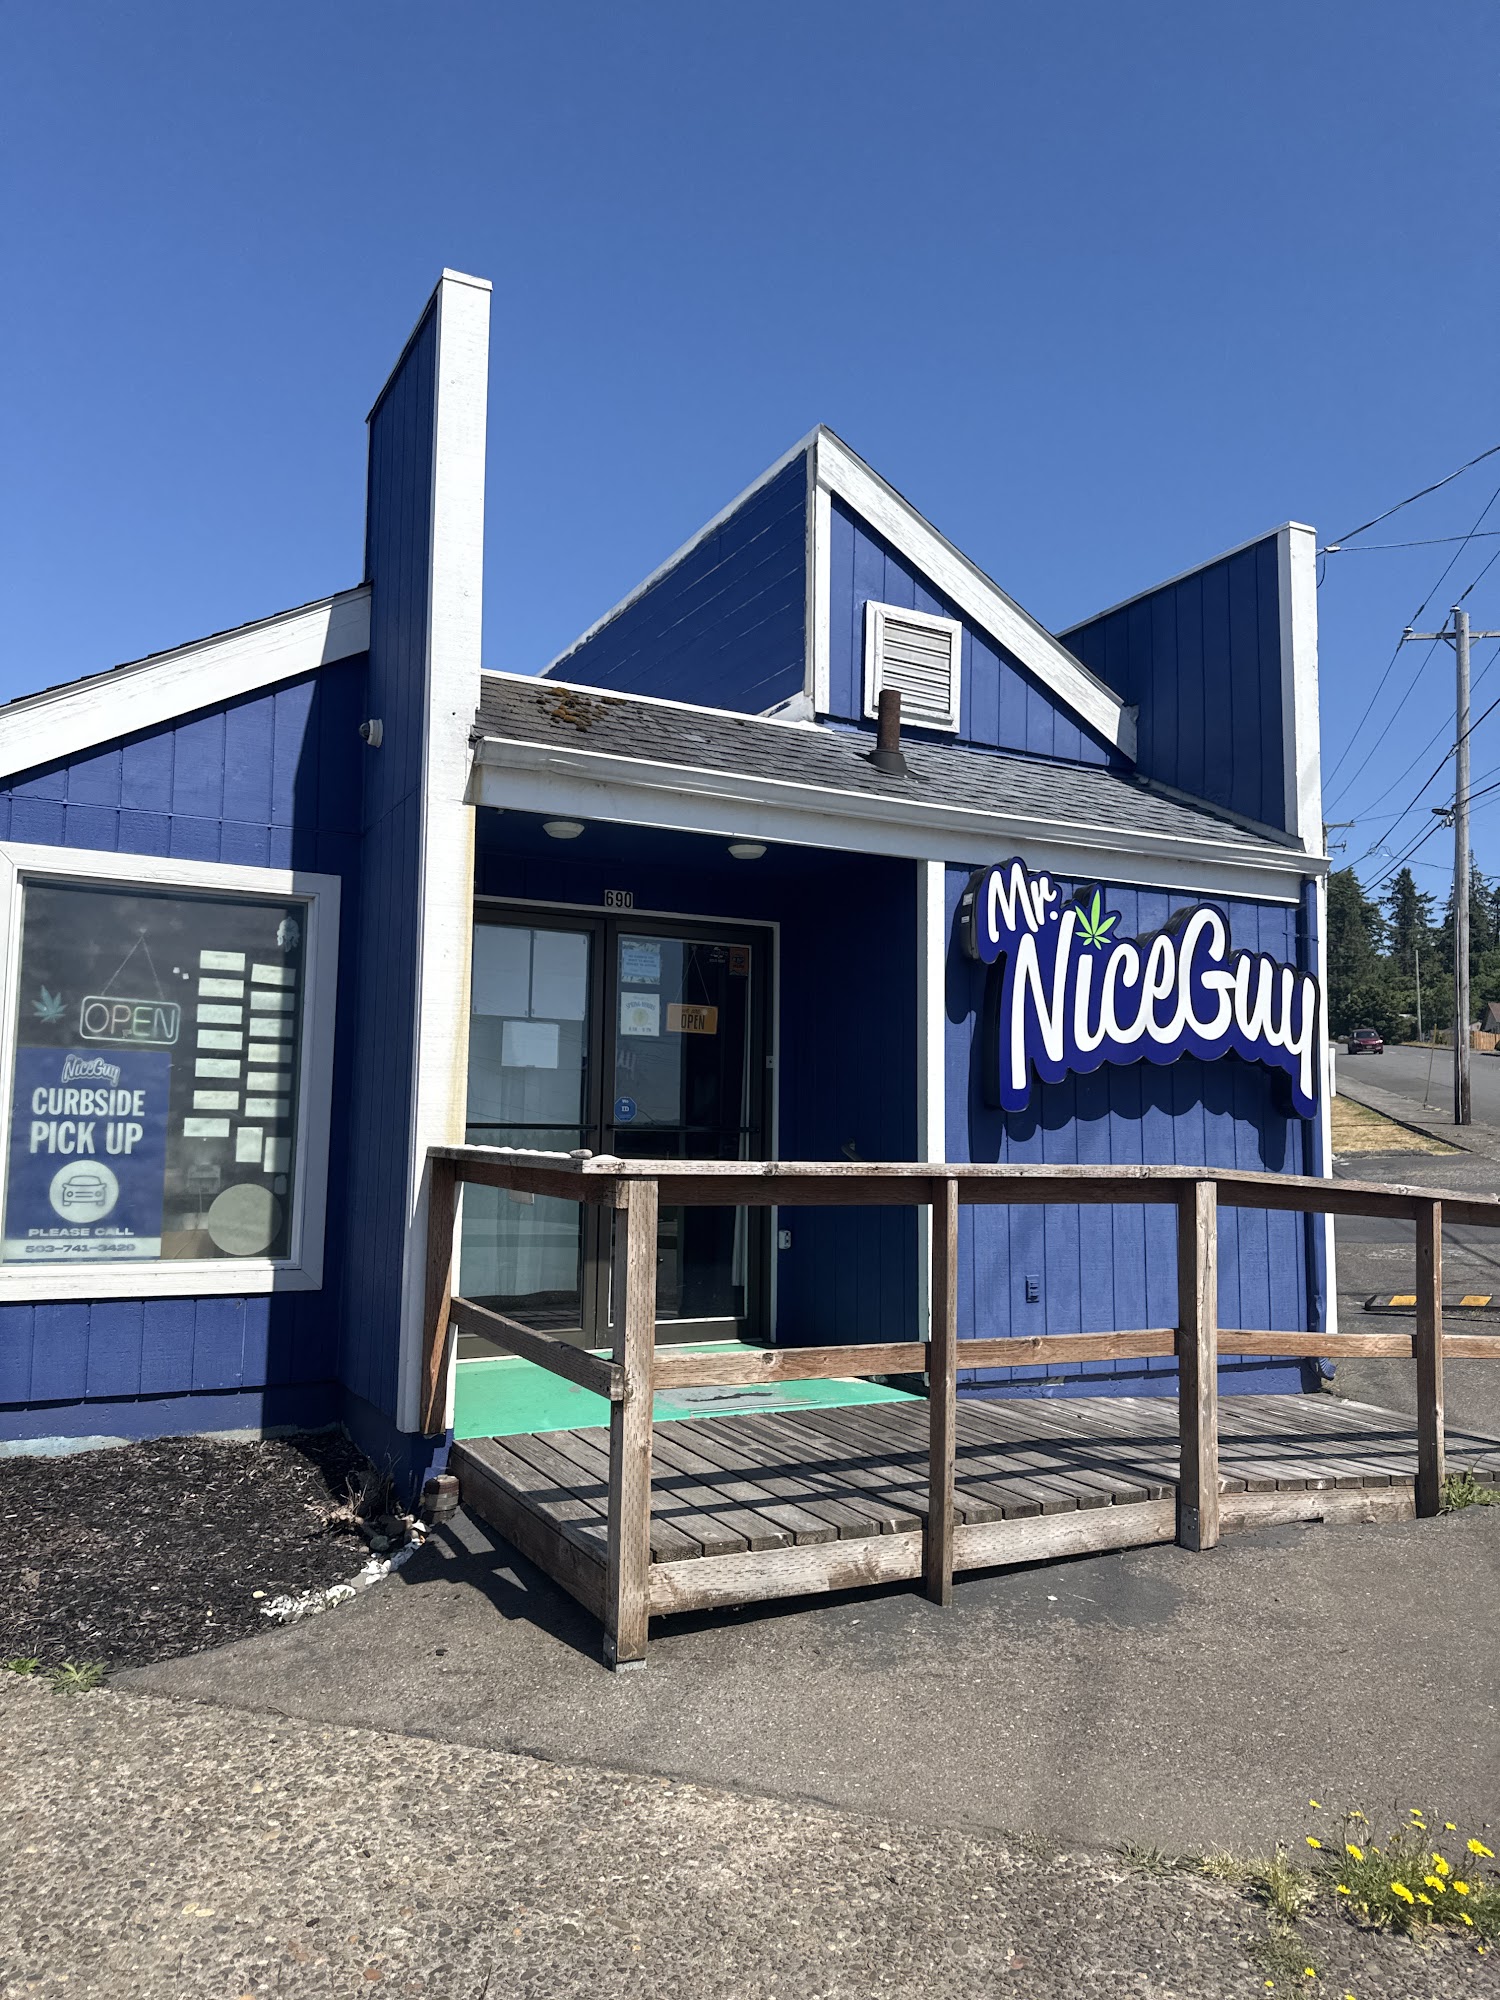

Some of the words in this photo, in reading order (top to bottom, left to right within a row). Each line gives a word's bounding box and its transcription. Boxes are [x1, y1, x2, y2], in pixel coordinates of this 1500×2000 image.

[606, 890, 632, 908] 690
[987, 862, 1058, 943] Mr.
[85, 1003, 175, 1038] OPEN
[681, 1014, 705, 1030] OPEN
[32, 1087, 146, 1116] CURBSIDE
[30, 1121, 96, 1154] PICK
[106, 1122, 143, 1155] UP
[28, 1228, 90, 1237] PLEASE
[95, 1227, 134, 1236] CALL
